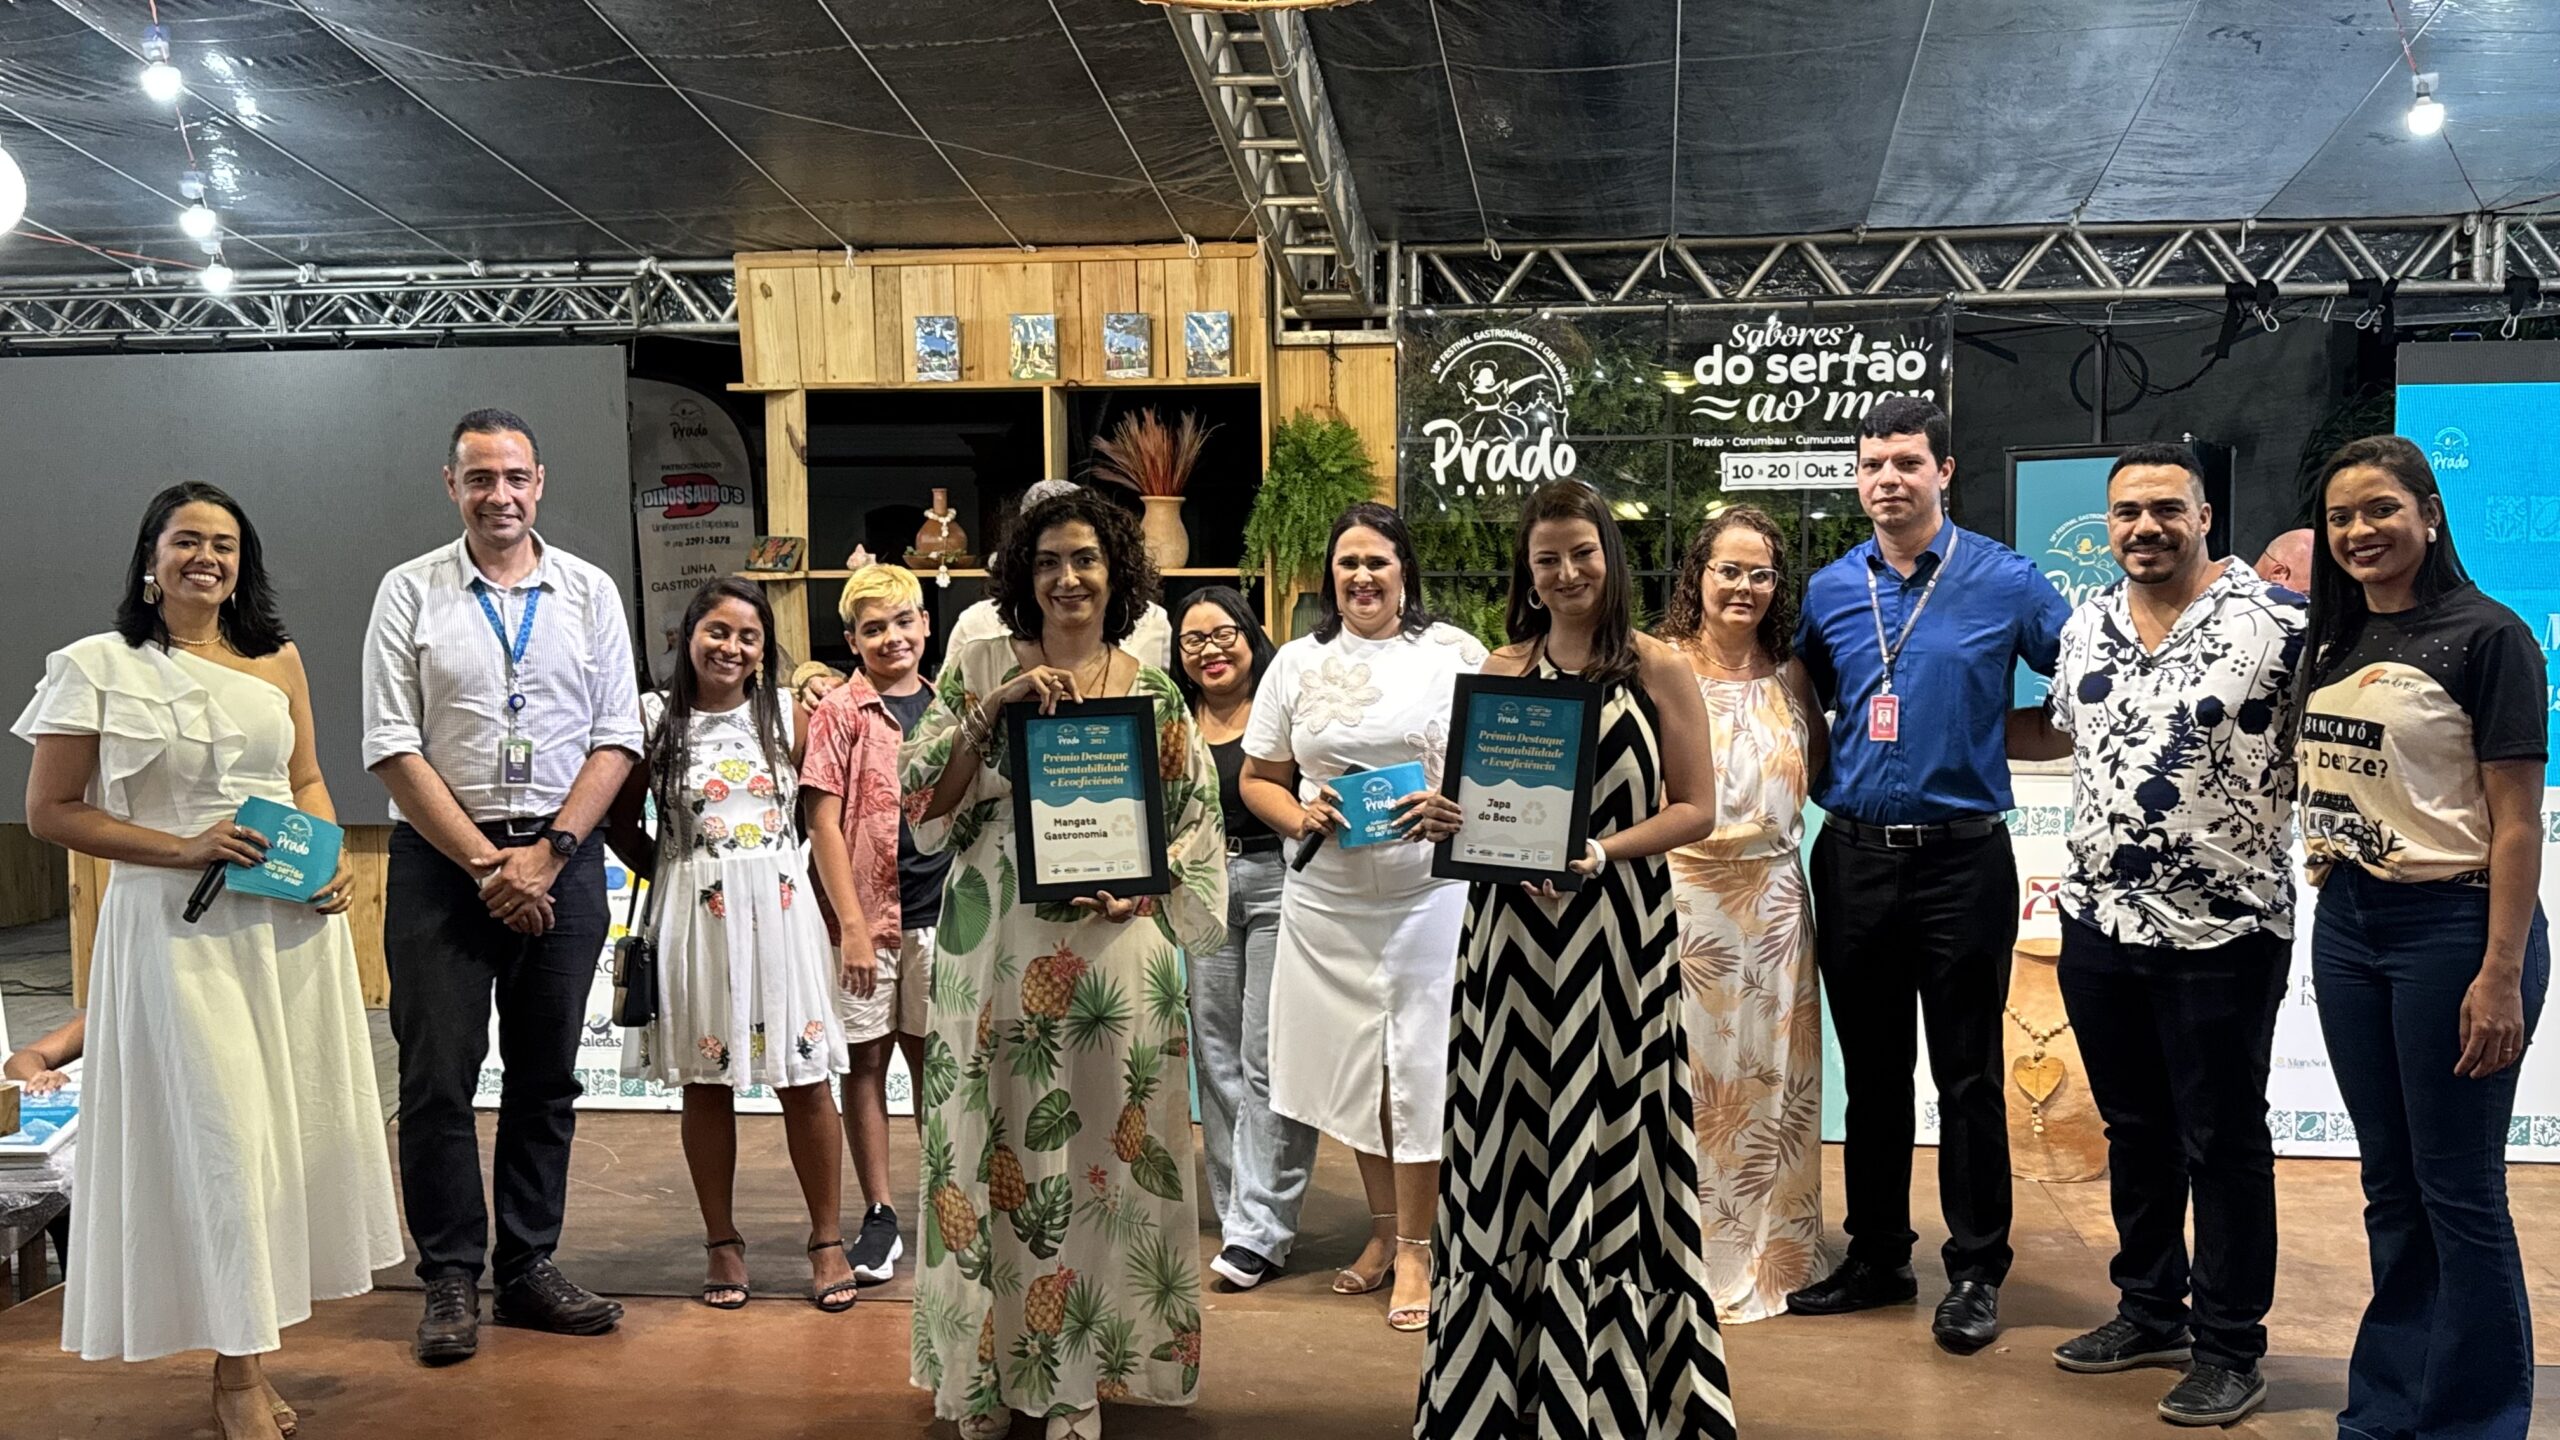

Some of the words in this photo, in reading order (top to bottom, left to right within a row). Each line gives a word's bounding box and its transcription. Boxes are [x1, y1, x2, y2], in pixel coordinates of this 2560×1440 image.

[1728, 319, 1854, 353] Sabores
[1440, 336, 1473, 363] FESTIVAL
[1473, 328, 1538, 346] GASTRONÔMICO
[1536, 341, 1545, 350] E
[1542, 346, 1568, 384] CULTURAL
[1563, 383, 1575, 397] DE
[1693, 343, 1754, 386] do
[1765, 331, 1927, 387] sertão
[1746, 386, 1820, 423] ao
[670, 422, 708, 439] Prado
[1693, 437, 1724, 447] Prado
[1732, 435, 1788, 447] Corumbau
[1795, 434, 1857, 446] Cumuruxat
[1422, 418, 1577, 486] Prado
[2432, 450, 2469, 470] Prado
[661, 462, 722, 472] PATROCINADOR
[1732, 464, 1753, 479] 10
[1757, 467, 1764, 476] a
[1767, 463, 1790, 478] 20
[1804, 462, 1838, 478] Out
[642, 484, 745, 508] DINOSSAURO'S
[681, 563, 717, 576] LINHA
[2044, 570, 2107, 610] Pra
[2304, 716, 2343, 743] BENÇA
[1057, 735, 1080, 746] Prado
[1517, 733, 1566, 748] Destaque
[1081, 751, 1128, 763] Destaque
[1476, 742, 1565, 758] Sustentabilidade
[1042, 762, 1130, 775] Sustentabilidade
[2317, 747, 2389, 779] benze?
[1362, 796, 1397, 812] Prado
[1487, 798, 1511, 811] Japa
[1053, 817, 1097, 829] Mangata
[1478, 811, 1491, 822] do
[1493, 812, 1517, 823] Beco
[1044, 828, 1108, 841] Gastronomia
[277, 831, 310, 856] Prado
[580, 1033, 623, 1048] aleias
